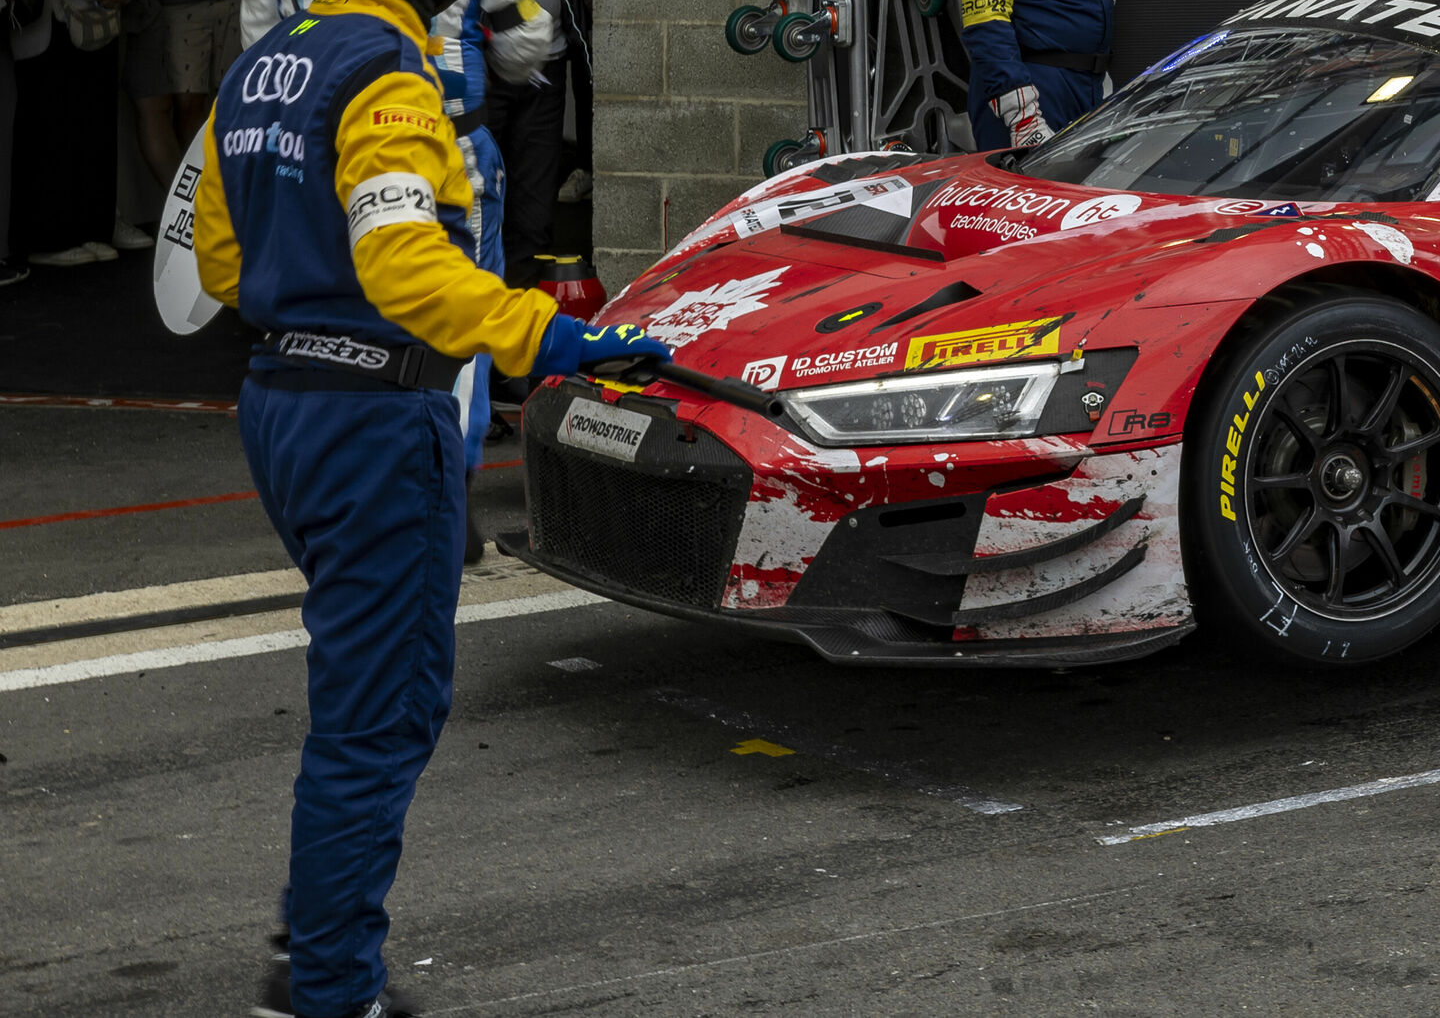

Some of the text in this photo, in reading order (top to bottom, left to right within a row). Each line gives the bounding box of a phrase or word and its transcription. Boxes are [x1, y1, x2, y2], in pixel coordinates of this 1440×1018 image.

[373, 111, 437, 133] PIRELLI
[927, 182, 1070, 219] hutchison
[950, 214, 1038, 242] technologies
[792, 342, 898, 371] ID CUSTOM
[921, 326, 1045, 362] PIRELLI
[855, 357, 894, 368] ATELIER
[571, 415, 641, 446] CROWDSTRIKE
[1123, 412, 1170, 431] R8
[1220, 371, 1266, 521] PIRELLI
